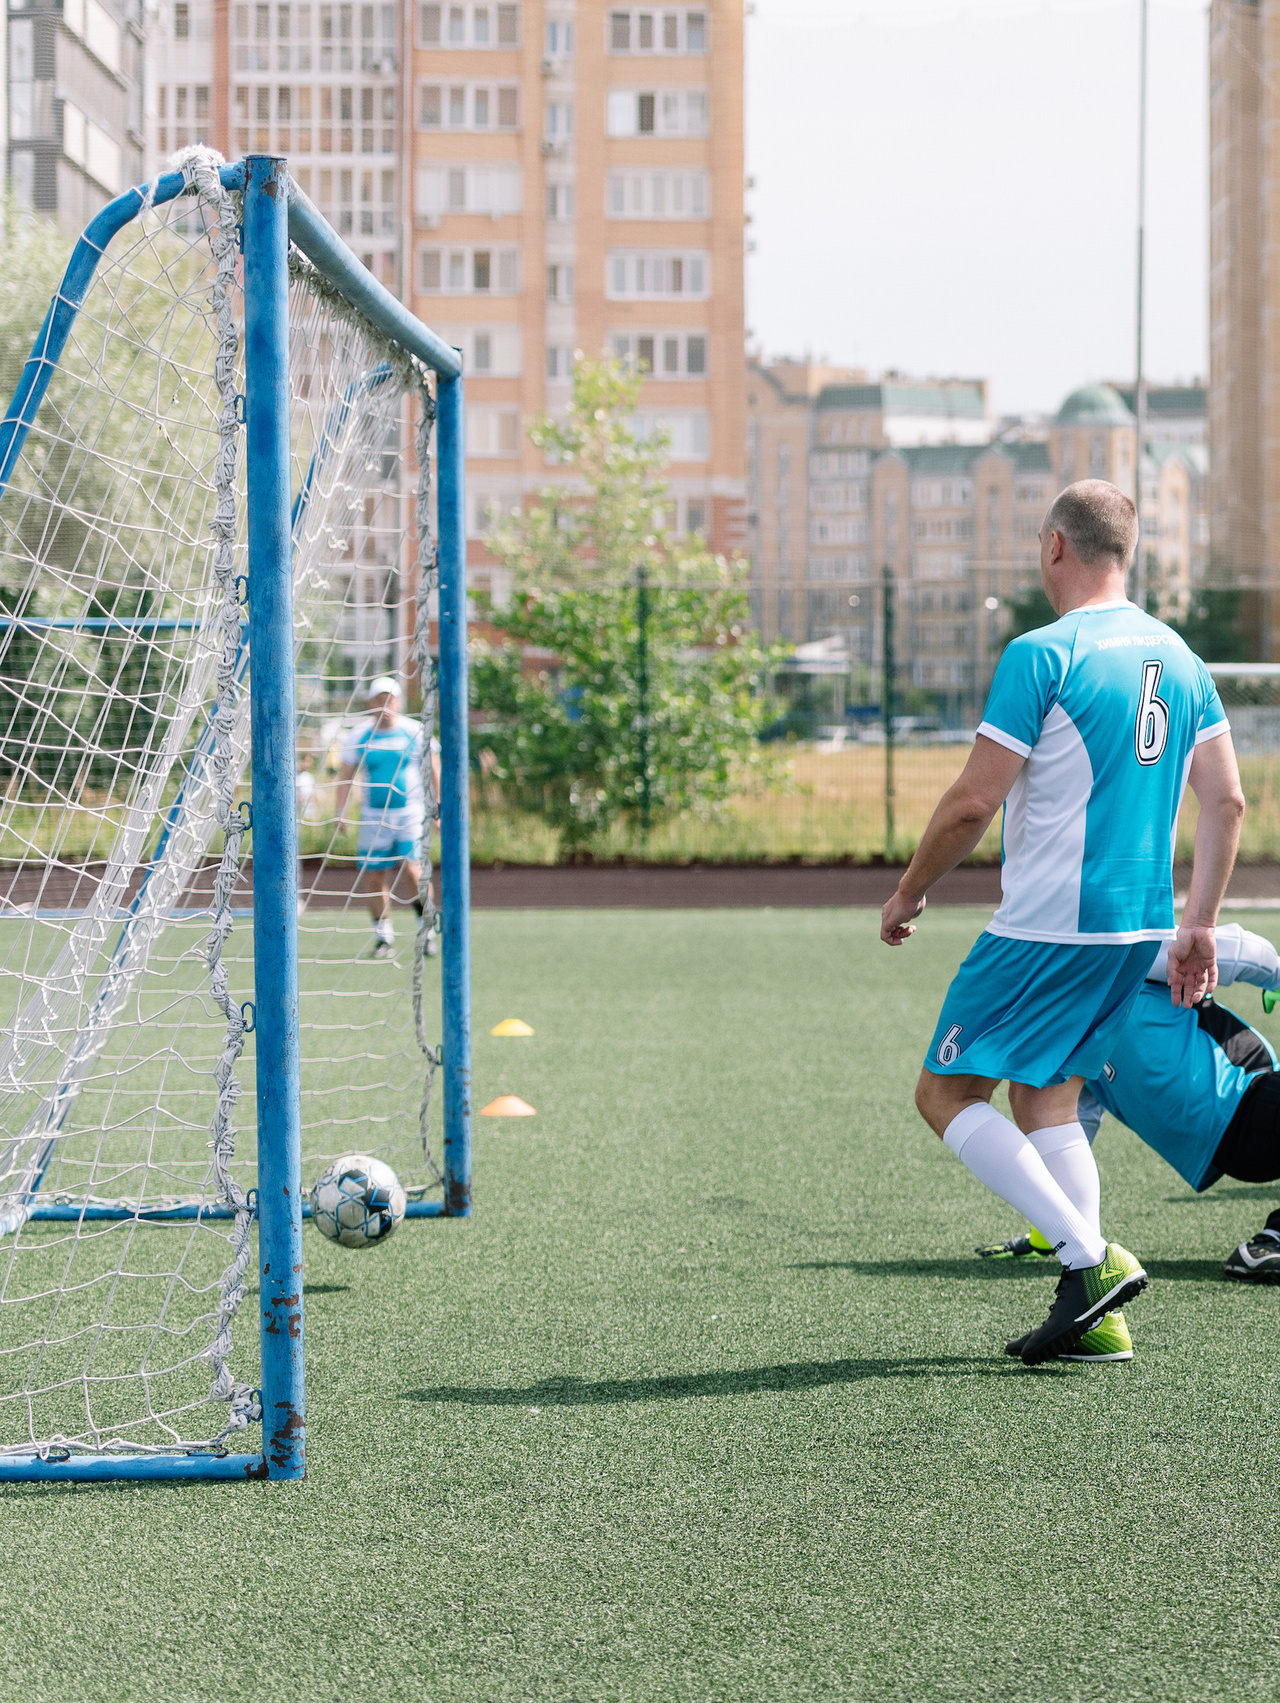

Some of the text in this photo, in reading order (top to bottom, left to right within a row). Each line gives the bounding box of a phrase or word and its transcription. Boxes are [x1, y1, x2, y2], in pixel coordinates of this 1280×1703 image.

[1095, 636, 1131, 650] ХИМИЯ
[1135, 660, 1169, 766] 6
[936, 1023, 963, 1068] 6
